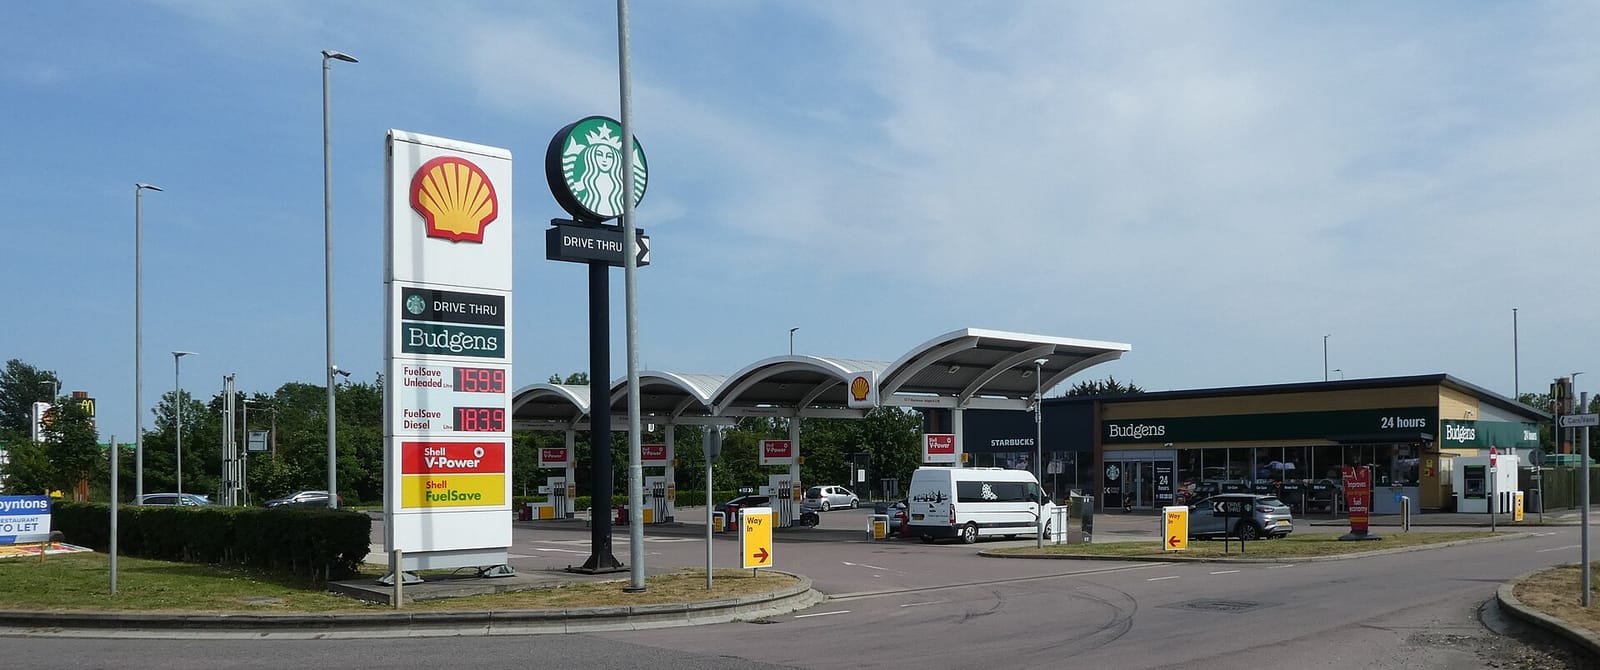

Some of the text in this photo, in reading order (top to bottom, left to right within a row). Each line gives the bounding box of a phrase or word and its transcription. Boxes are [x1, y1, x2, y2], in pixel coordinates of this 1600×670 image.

[563, 235, 623, 252] DRIVE THRU
[433, 300, 497, 316] DRIVE THRU
[408, 327, 498, 352] Budgens
[403, 366, 441, 376] FuelSave
[404, 378, 442, 388] Unleaded
[459, 368, 504, 393] 159.9
[403, 409, 441, 418] FuelSave
[403, 420, 430, 429] Diesel
[459, 408, 504, 432] 183.9
[1381, 416, 1426, 429] 24 hours
[1109, 423, 1166, 439] Budgens
[1446, 424, 1476, 443] Budgens
[991, 438, 1034, 446] STARBUCKS
[424, 447, 446, 456] Shell
[424, 457, 480, 468] V-Power
[426, 480, 447, 488] Shell
[1159, 475, 1168, 485] 24
[426, 490, 481, 501] FuelSave
[747, 517, 762, 526] Way
[18, 523, 38, 532] LET
